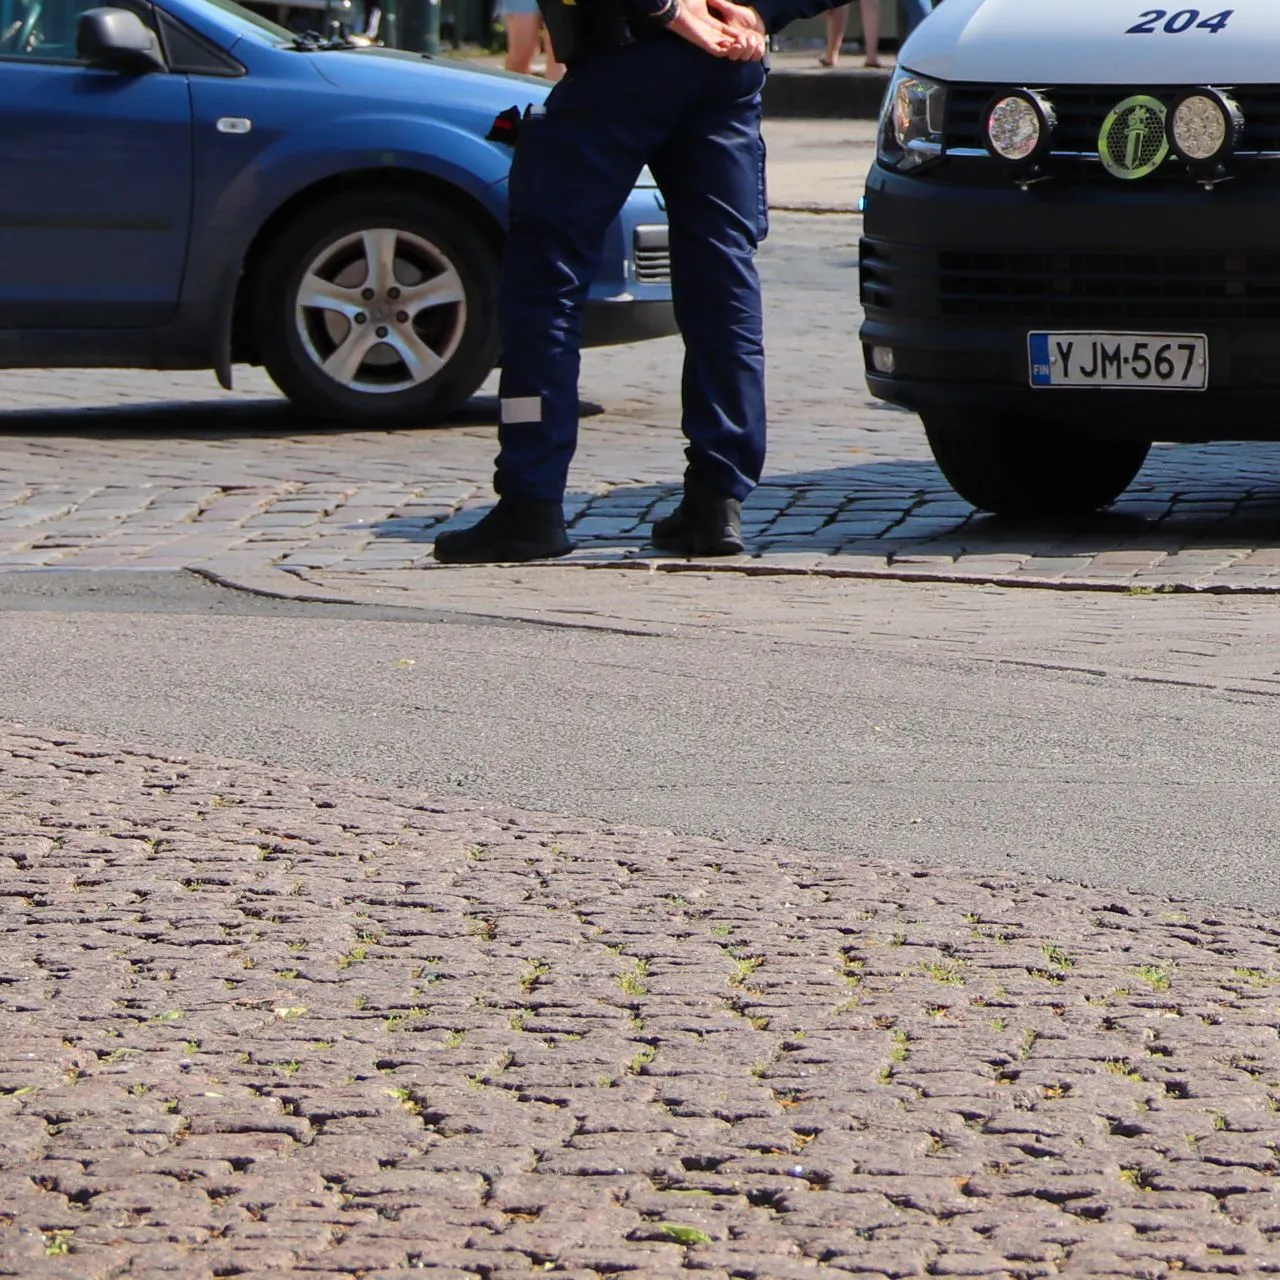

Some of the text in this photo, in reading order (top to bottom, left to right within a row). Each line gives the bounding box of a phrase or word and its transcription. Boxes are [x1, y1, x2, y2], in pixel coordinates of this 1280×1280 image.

[1125, 8, 1236, 35] 204
[1031, 340, 1196, 382] FIN YJM-567
